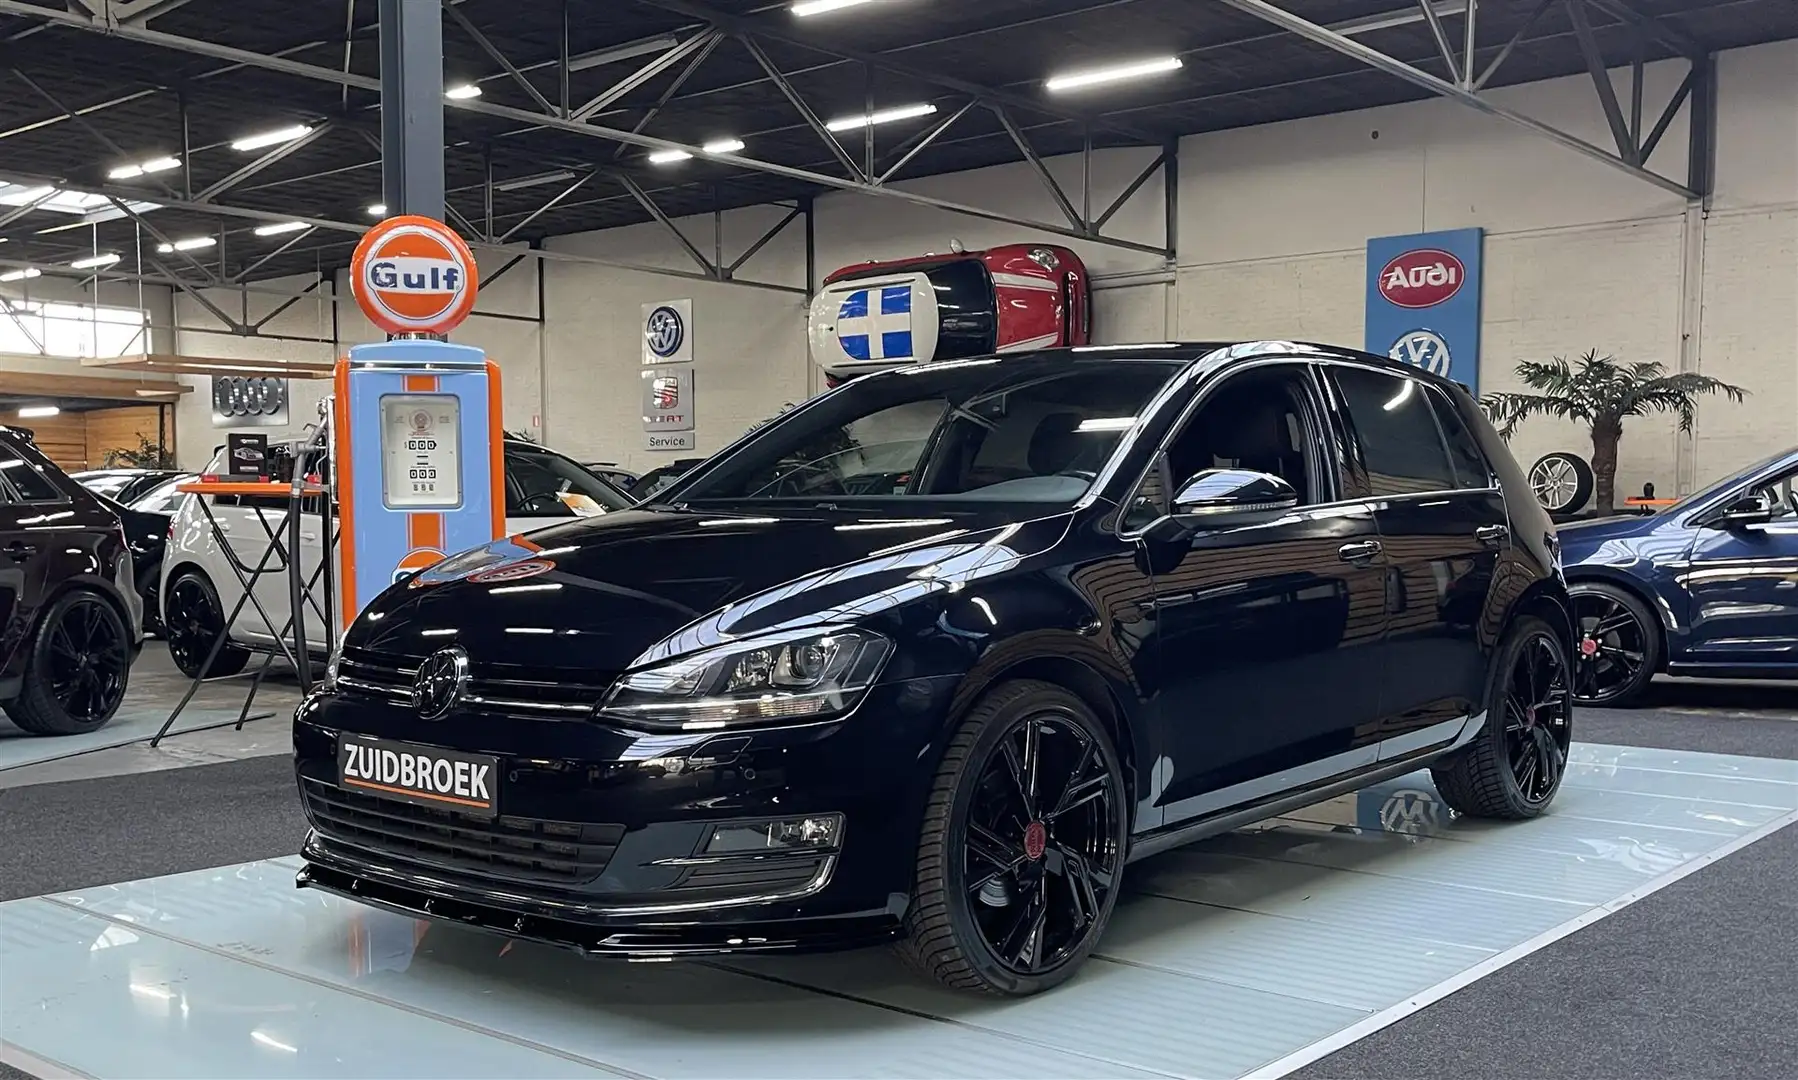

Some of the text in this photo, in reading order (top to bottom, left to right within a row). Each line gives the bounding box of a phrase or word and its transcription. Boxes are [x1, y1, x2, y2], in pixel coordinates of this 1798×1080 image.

[371, 262, 459, 290] Gulf
[646, 415, 684, 423] EAT
[649, 437, 685, 446] Service
[344, 743, 490, 800] ZUIDBROEK
